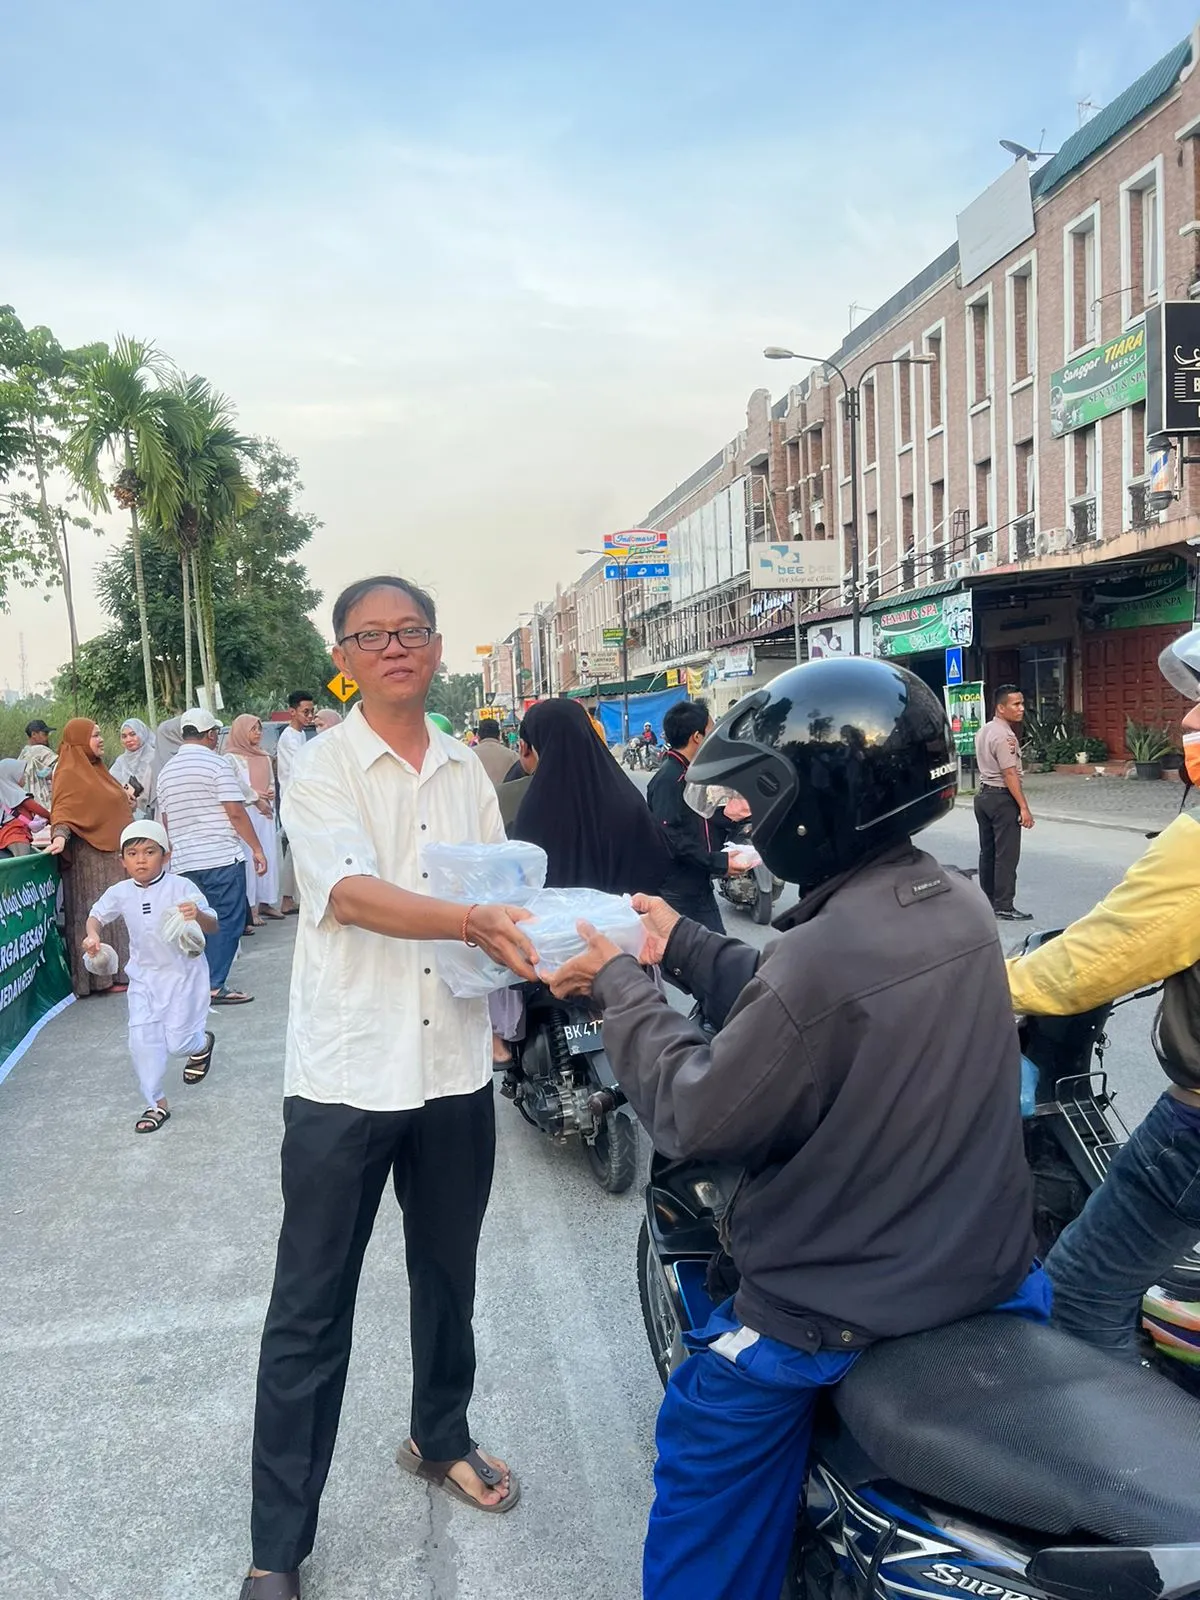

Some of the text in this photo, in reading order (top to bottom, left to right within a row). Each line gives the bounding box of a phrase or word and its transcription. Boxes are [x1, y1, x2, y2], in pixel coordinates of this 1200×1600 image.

[1063, 356, 1101, 383] Sanggar
[1104, 330, 1144, 364] TIARA
[1110, 353, 1138, 372] MERCI
[615, 534, 656, 543] Indomaret
[920, 603, 938, 618] SPA
[959, 693, 981, 703] YOGA
[563, 1024, 583, 1040] BK
